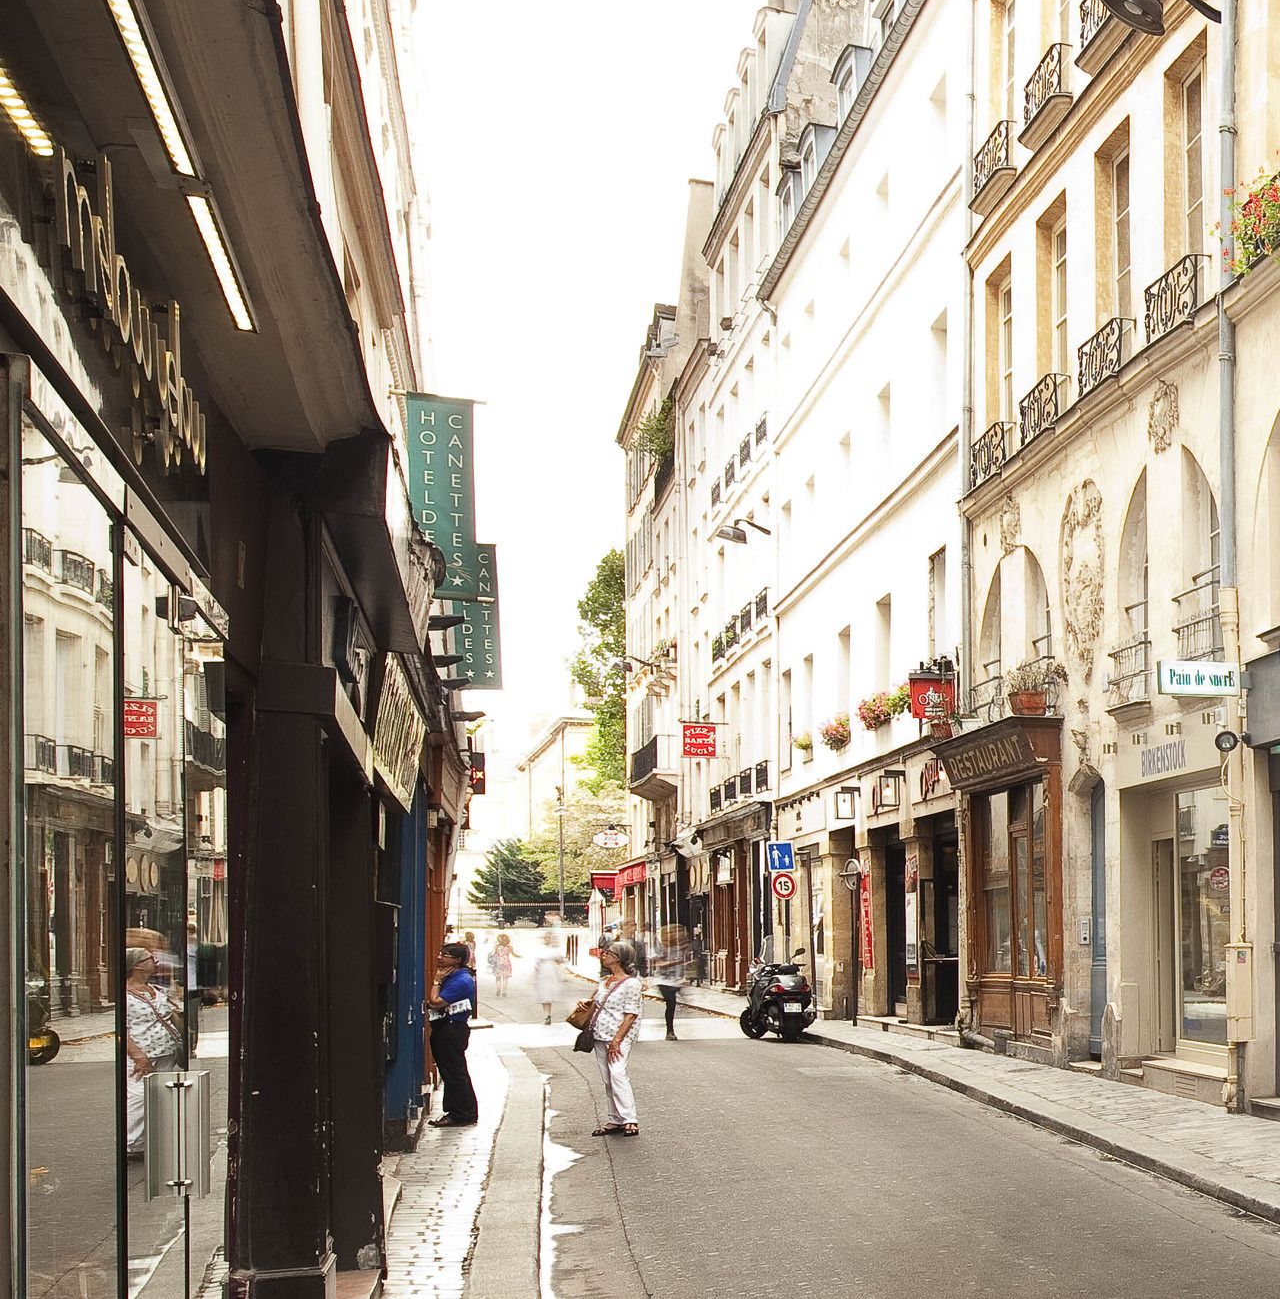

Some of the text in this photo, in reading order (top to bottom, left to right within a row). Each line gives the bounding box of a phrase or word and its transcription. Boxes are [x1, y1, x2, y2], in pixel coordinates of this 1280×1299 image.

[420, 410, 438, 505] HOTEL
[448, 414, 464, 567] CANETTES
[478, 552, 494, 665] CANTTES
[1169, 668, 1191, 686] Pain
[1195, 669, 1206, 686] de
[685, 727, 715, 739] PIZZA
[685, 737, 715, 745] SANTA
[685, 744, 715, 754] LUCIA
[949, 734, 1023, 781] RESTAURANT
[1141, 739, 1187, 778] BIRKENSTOCK
[778, 881, 790, 891] 15
